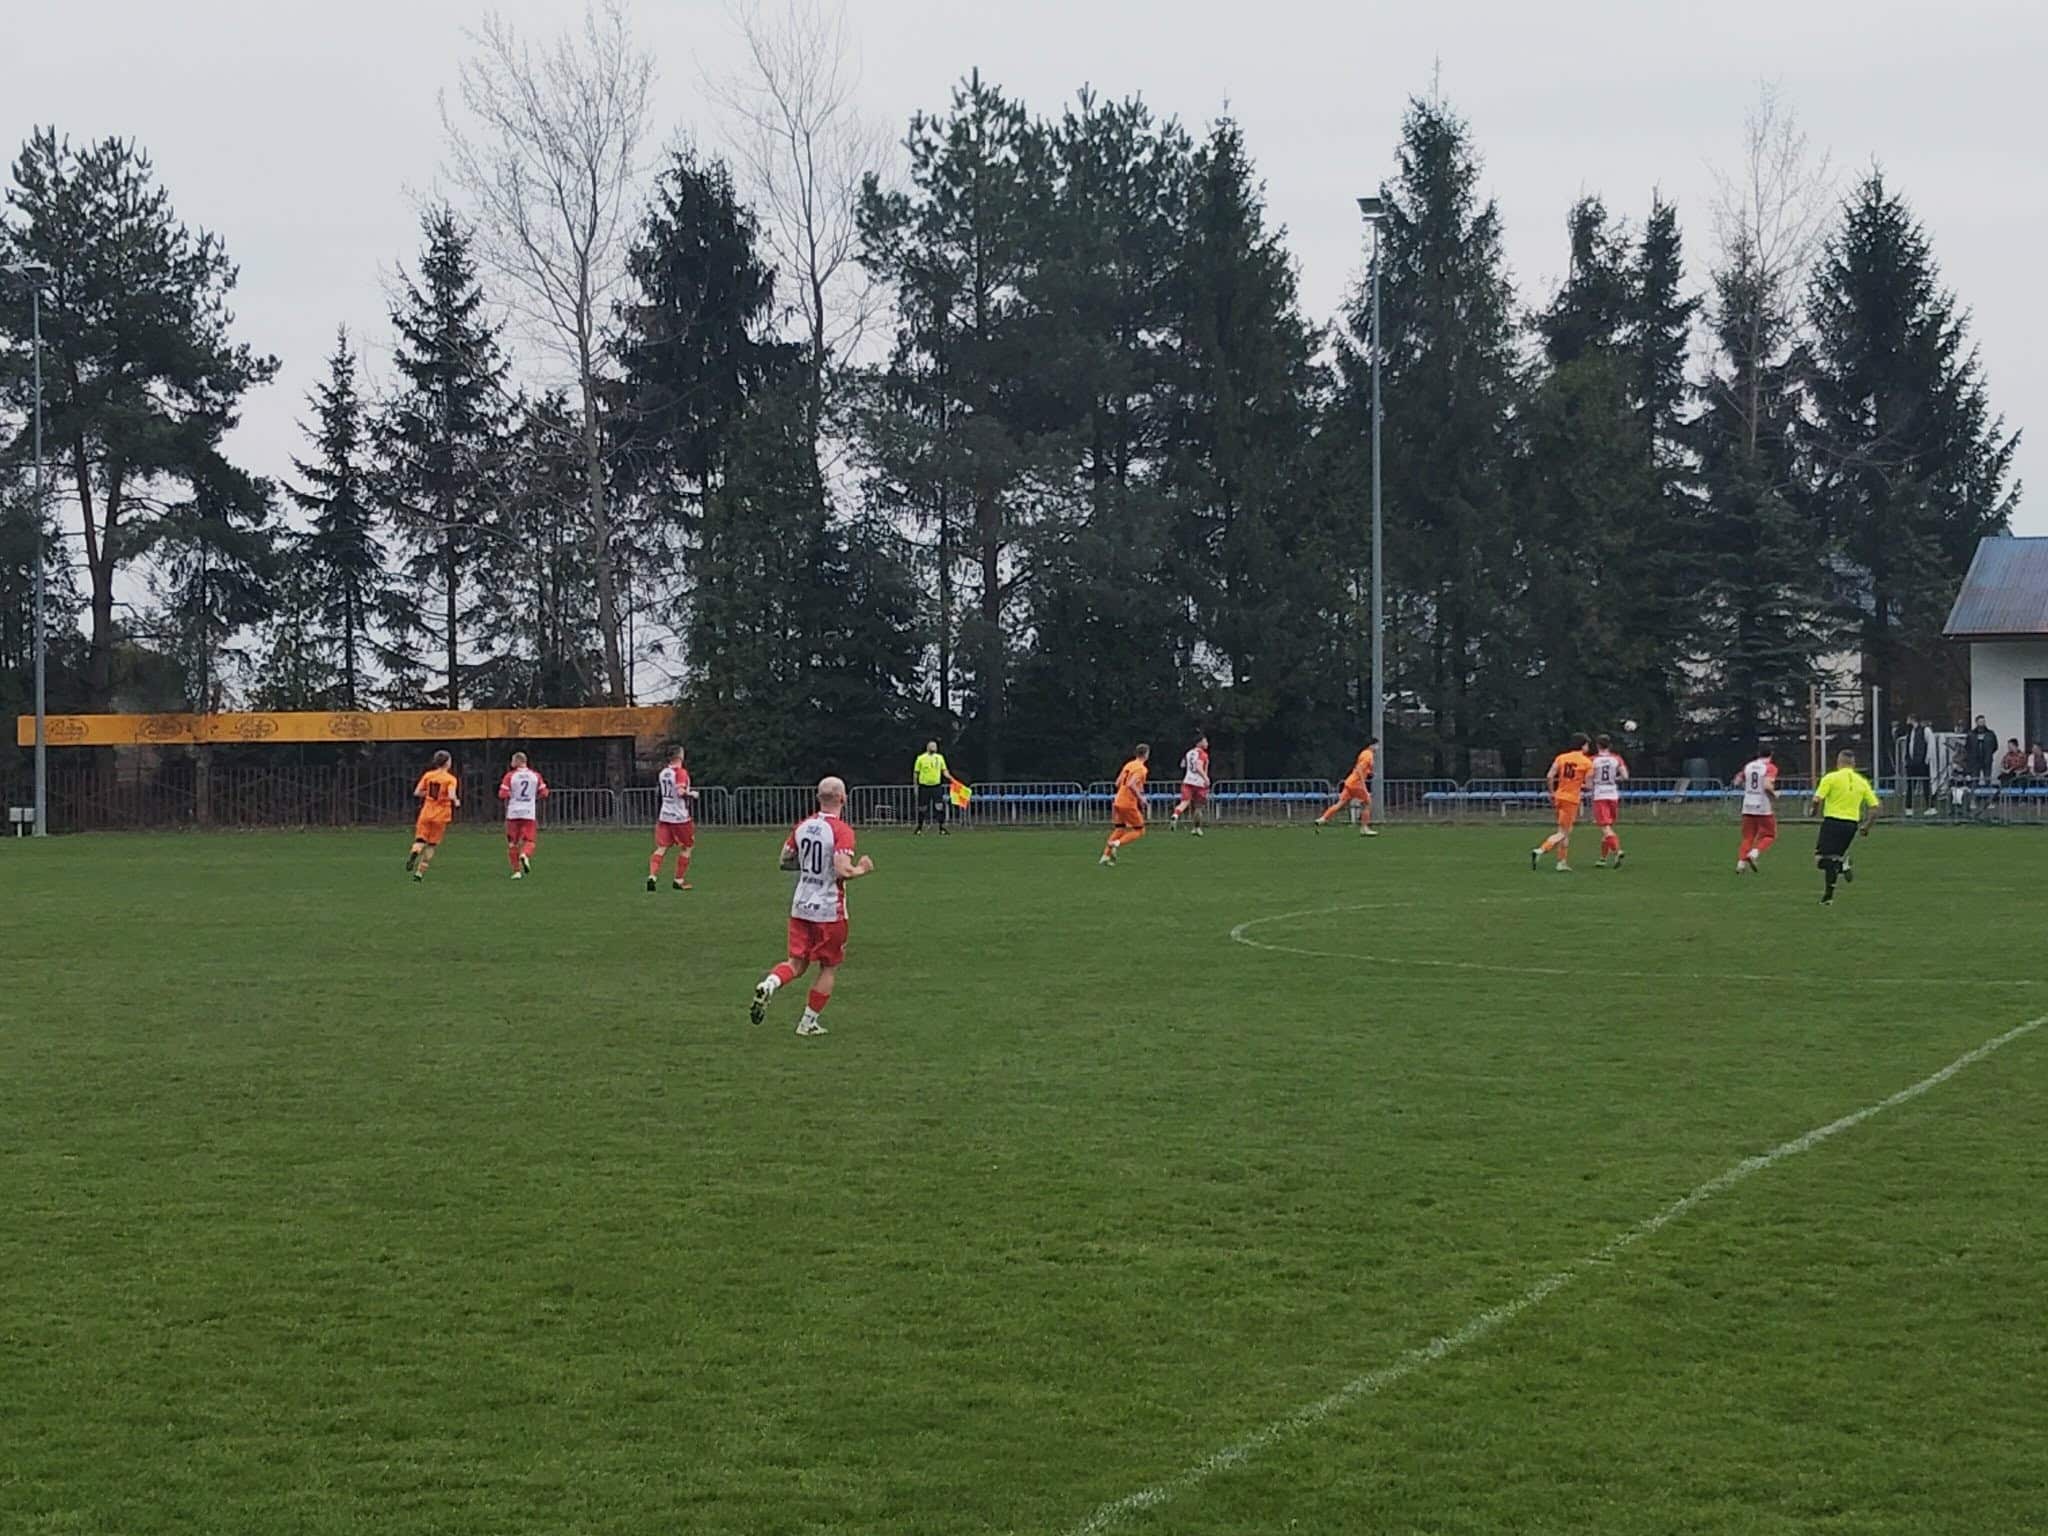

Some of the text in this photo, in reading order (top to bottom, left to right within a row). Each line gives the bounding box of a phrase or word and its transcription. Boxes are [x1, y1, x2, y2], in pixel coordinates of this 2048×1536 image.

[520, 780, 529, 797] 2
[1751, 771, 1759, 789] 8
[801, 838, 823, 875] 20
